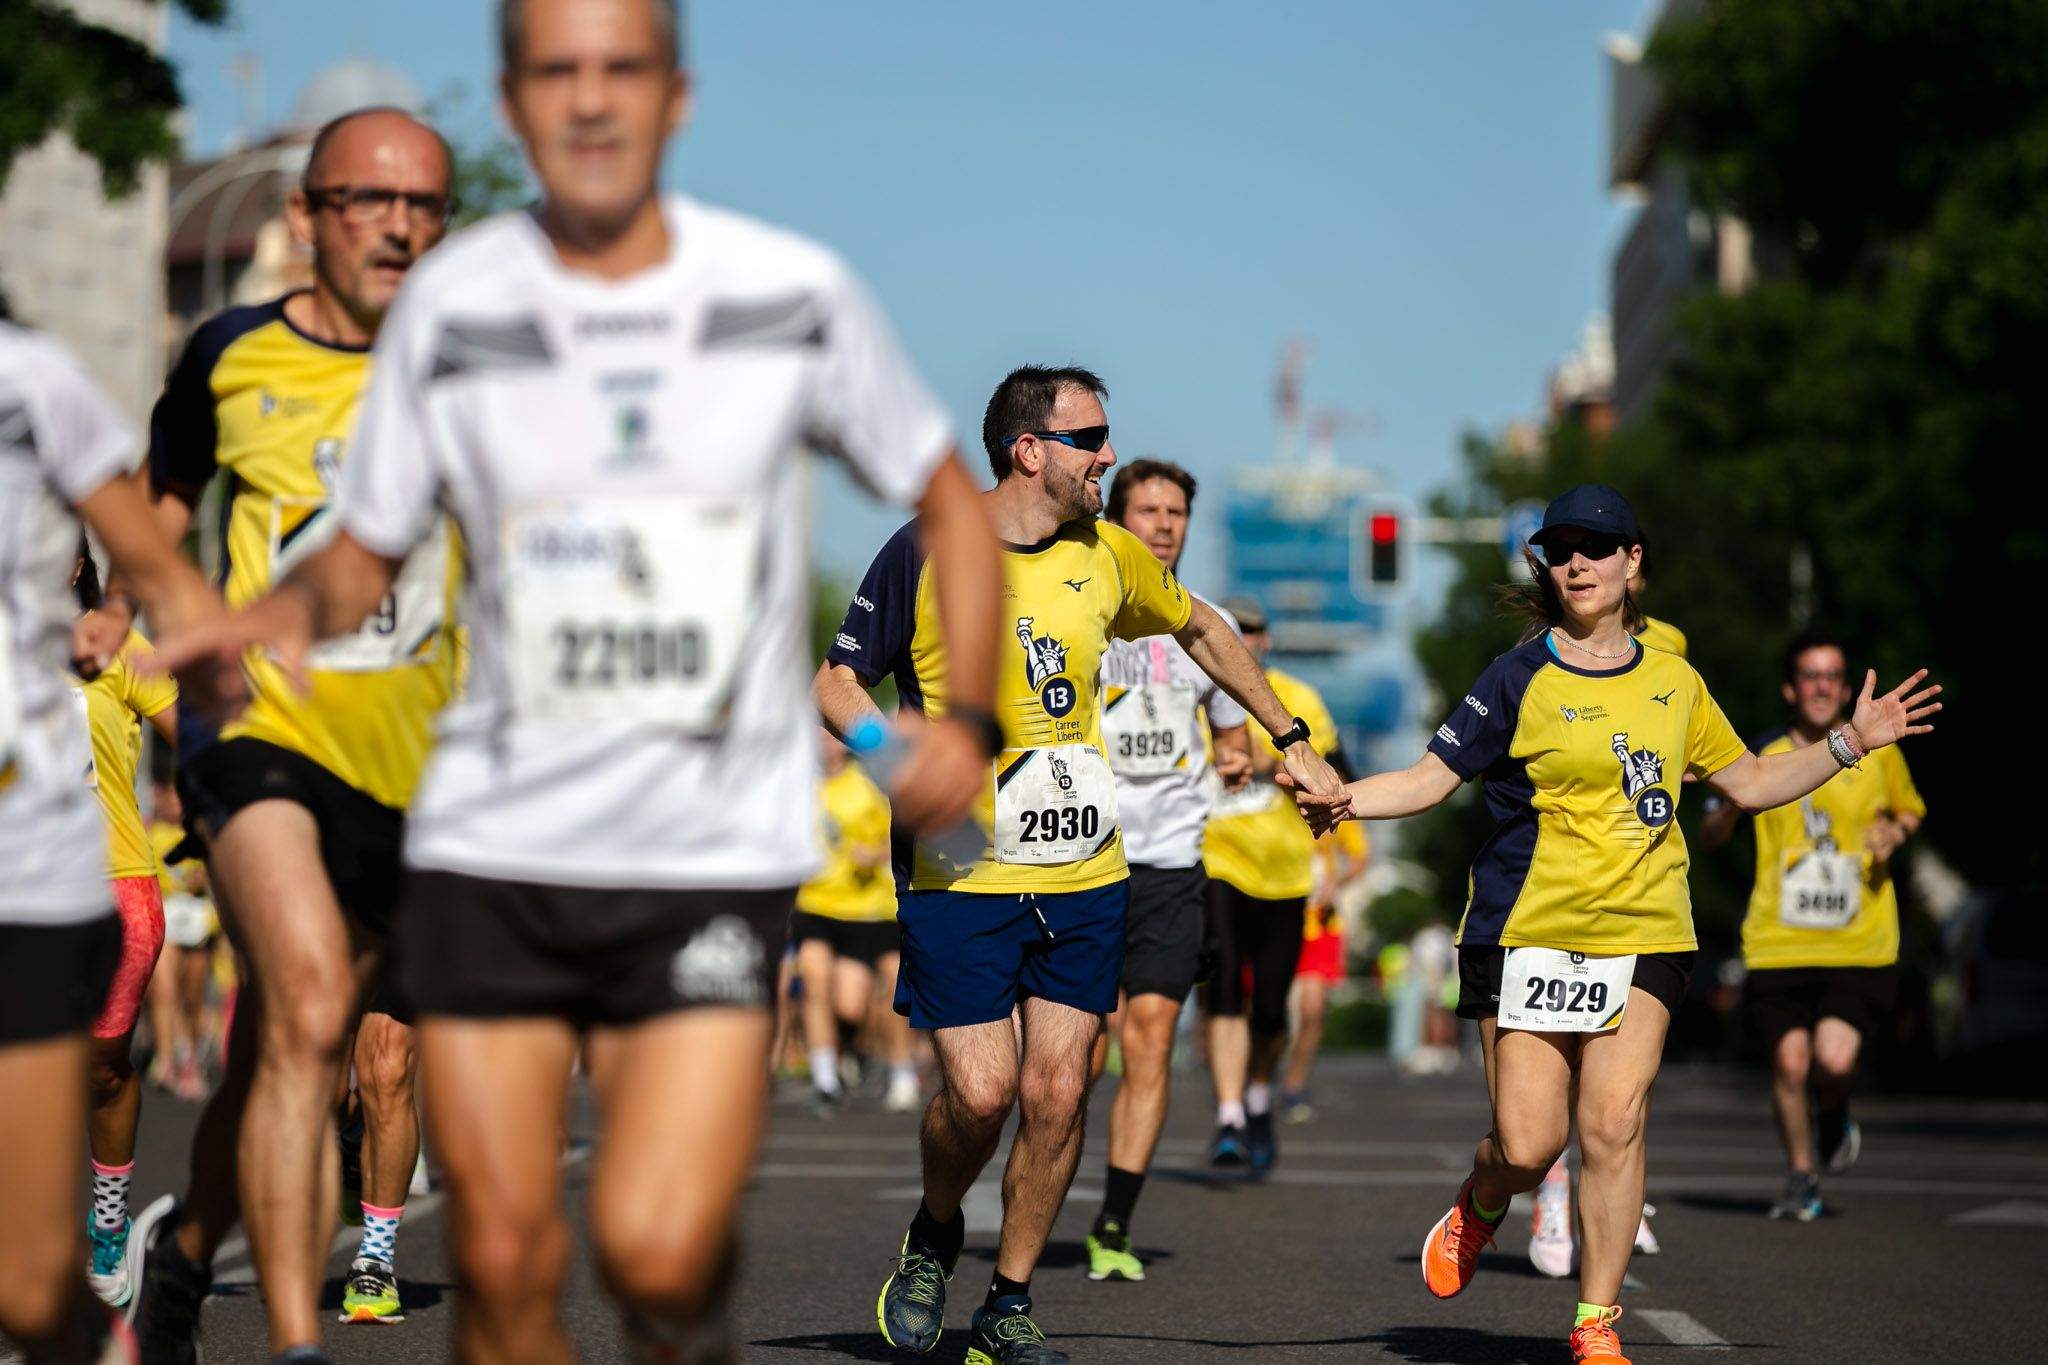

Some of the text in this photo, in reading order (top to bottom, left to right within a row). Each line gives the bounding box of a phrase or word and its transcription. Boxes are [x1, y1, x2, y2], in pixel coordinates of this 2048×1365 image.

[552, 619, 709, 687] 2200
[1047, 686, 1068, 709] 13
[1578, 705, 1603, 713] Liberty
[1057, 730, 1083, 742] Liberty
[1118, 730, 1175, 758] 3929
[1060, 778, 1070, 787] 13
[1643, 797, 1667, 818] 13
[1019, 804, 1099, 843] 2930
[1524, 976, 1608, 1013] 2929
